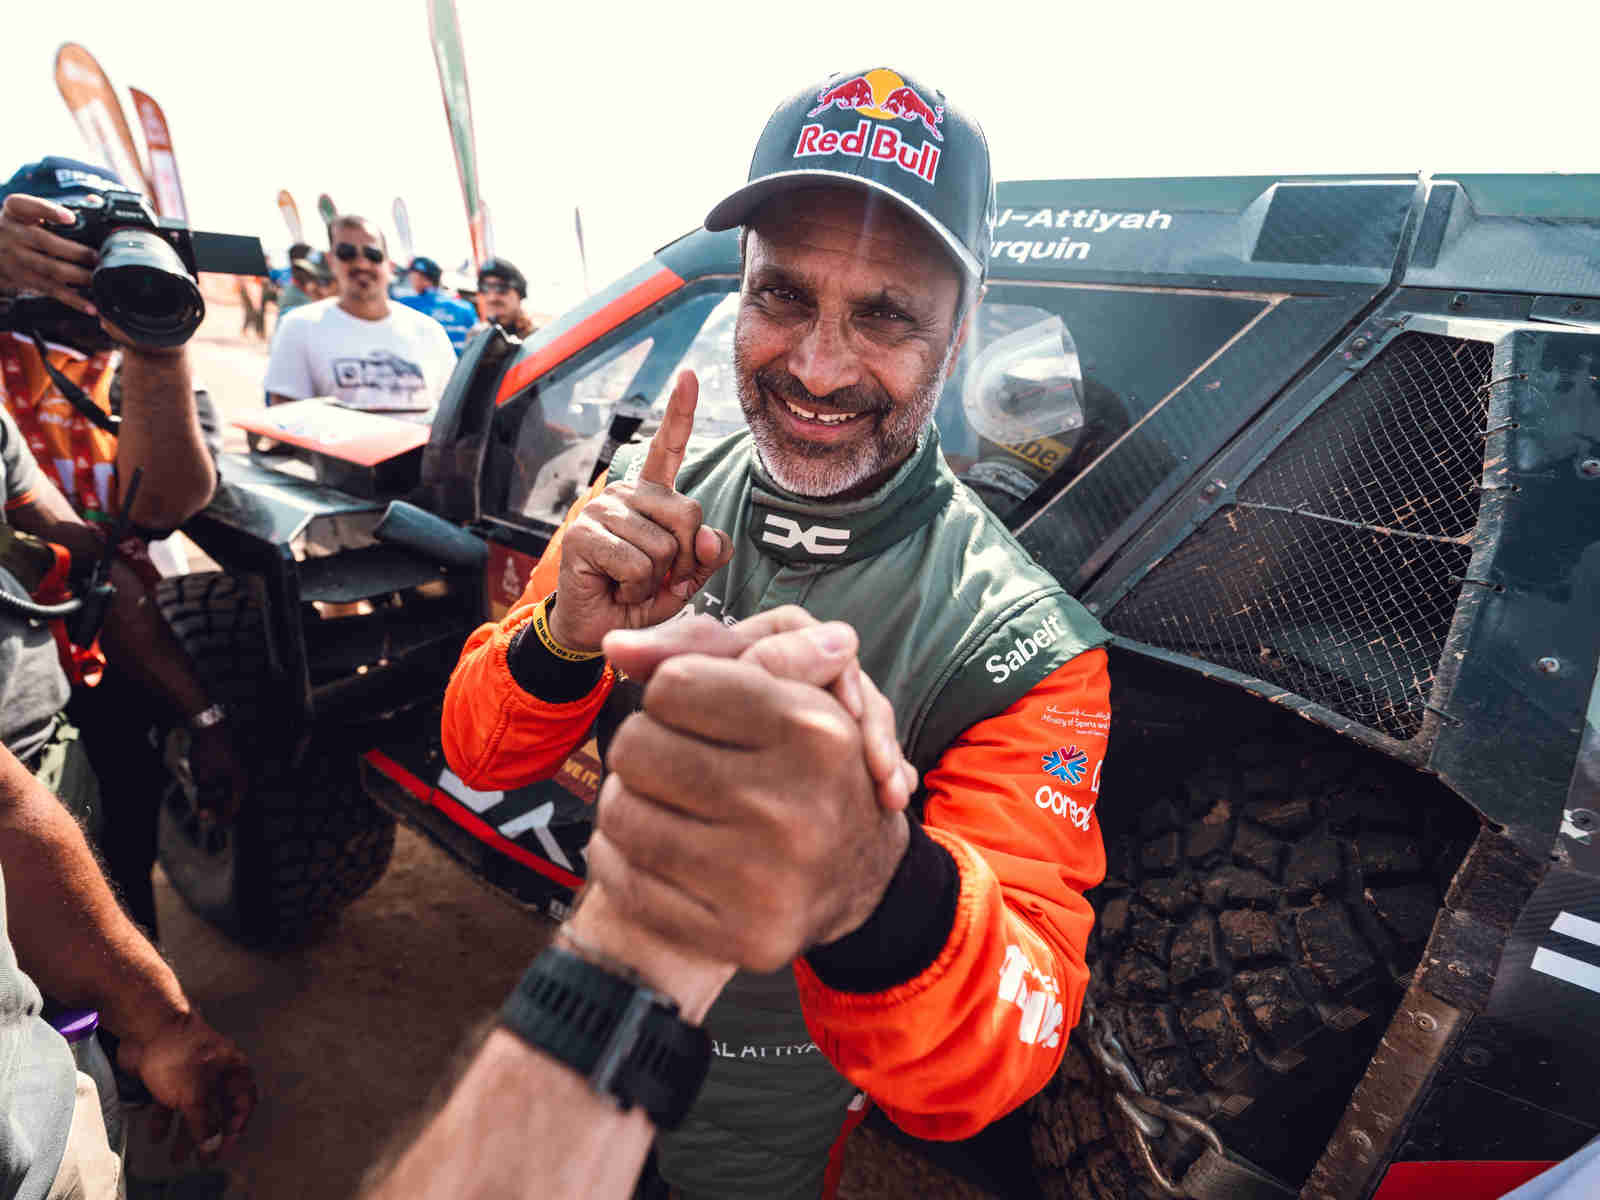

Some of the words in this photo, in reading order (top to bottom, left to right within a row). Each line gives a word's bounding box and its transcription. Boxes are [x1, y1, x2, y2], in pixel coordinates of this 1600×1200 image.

[793, 120, 871, 158] Red
[867, 124, 941, 184] Bull
[985, 611, 1067, 684] Sabelt
